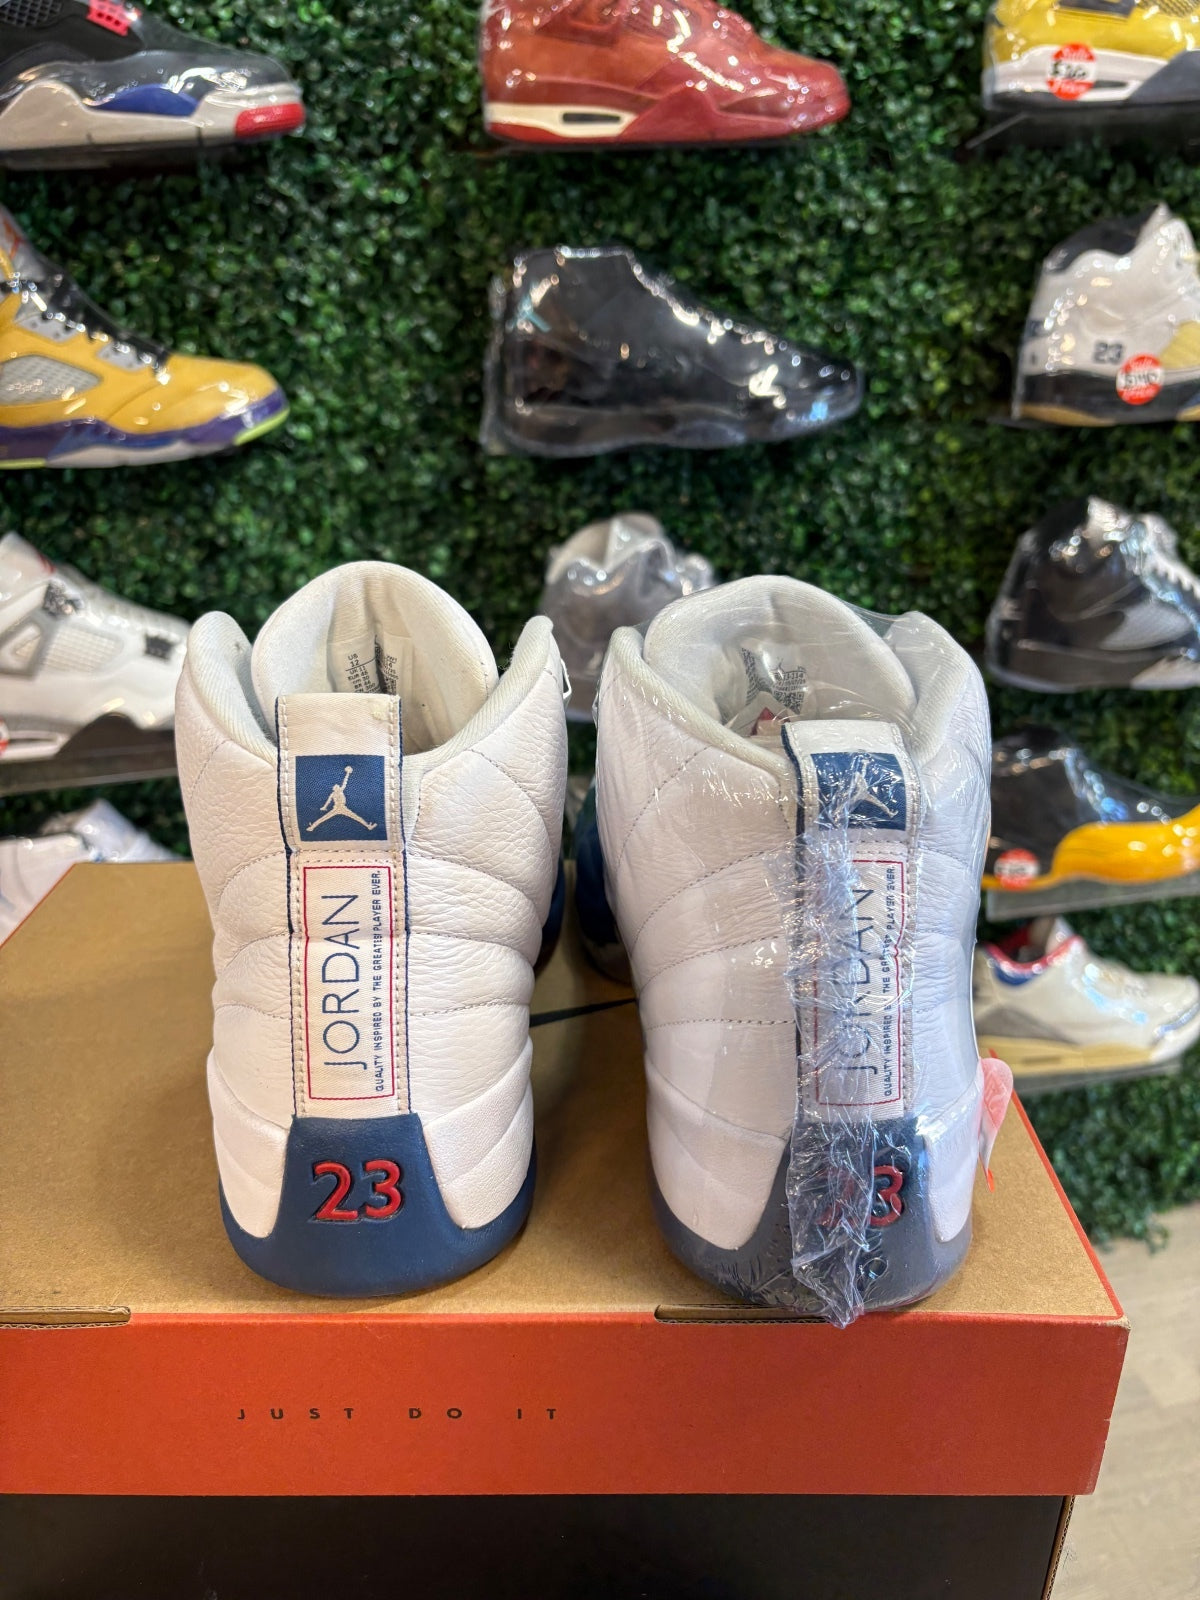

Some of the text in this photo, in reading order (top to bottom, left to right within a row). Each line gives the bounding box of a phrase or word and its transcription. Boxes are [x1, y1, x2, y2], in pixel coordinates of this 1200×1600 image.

[1093, 341, 1123, 365] 23
[372, 897, 382, 932] PLAYER
[321, 894, 367, 1070] JORDAN
[372, 974, 382, 992] THE
[882, 977, 891, 994] THE
[372, 997, 382, 1009] BY
[373, 1009, 383, 1050] INSPIRED
[883, 1014, 893, 1054] INSPIRED
[375, 1054, 385, 1092] QUALITY
[883, 1060, 893, 1097] QUALITY
[312, 1160, 404, 1221] 23
[237, 1407, 557, 1420] JUST DO IT
